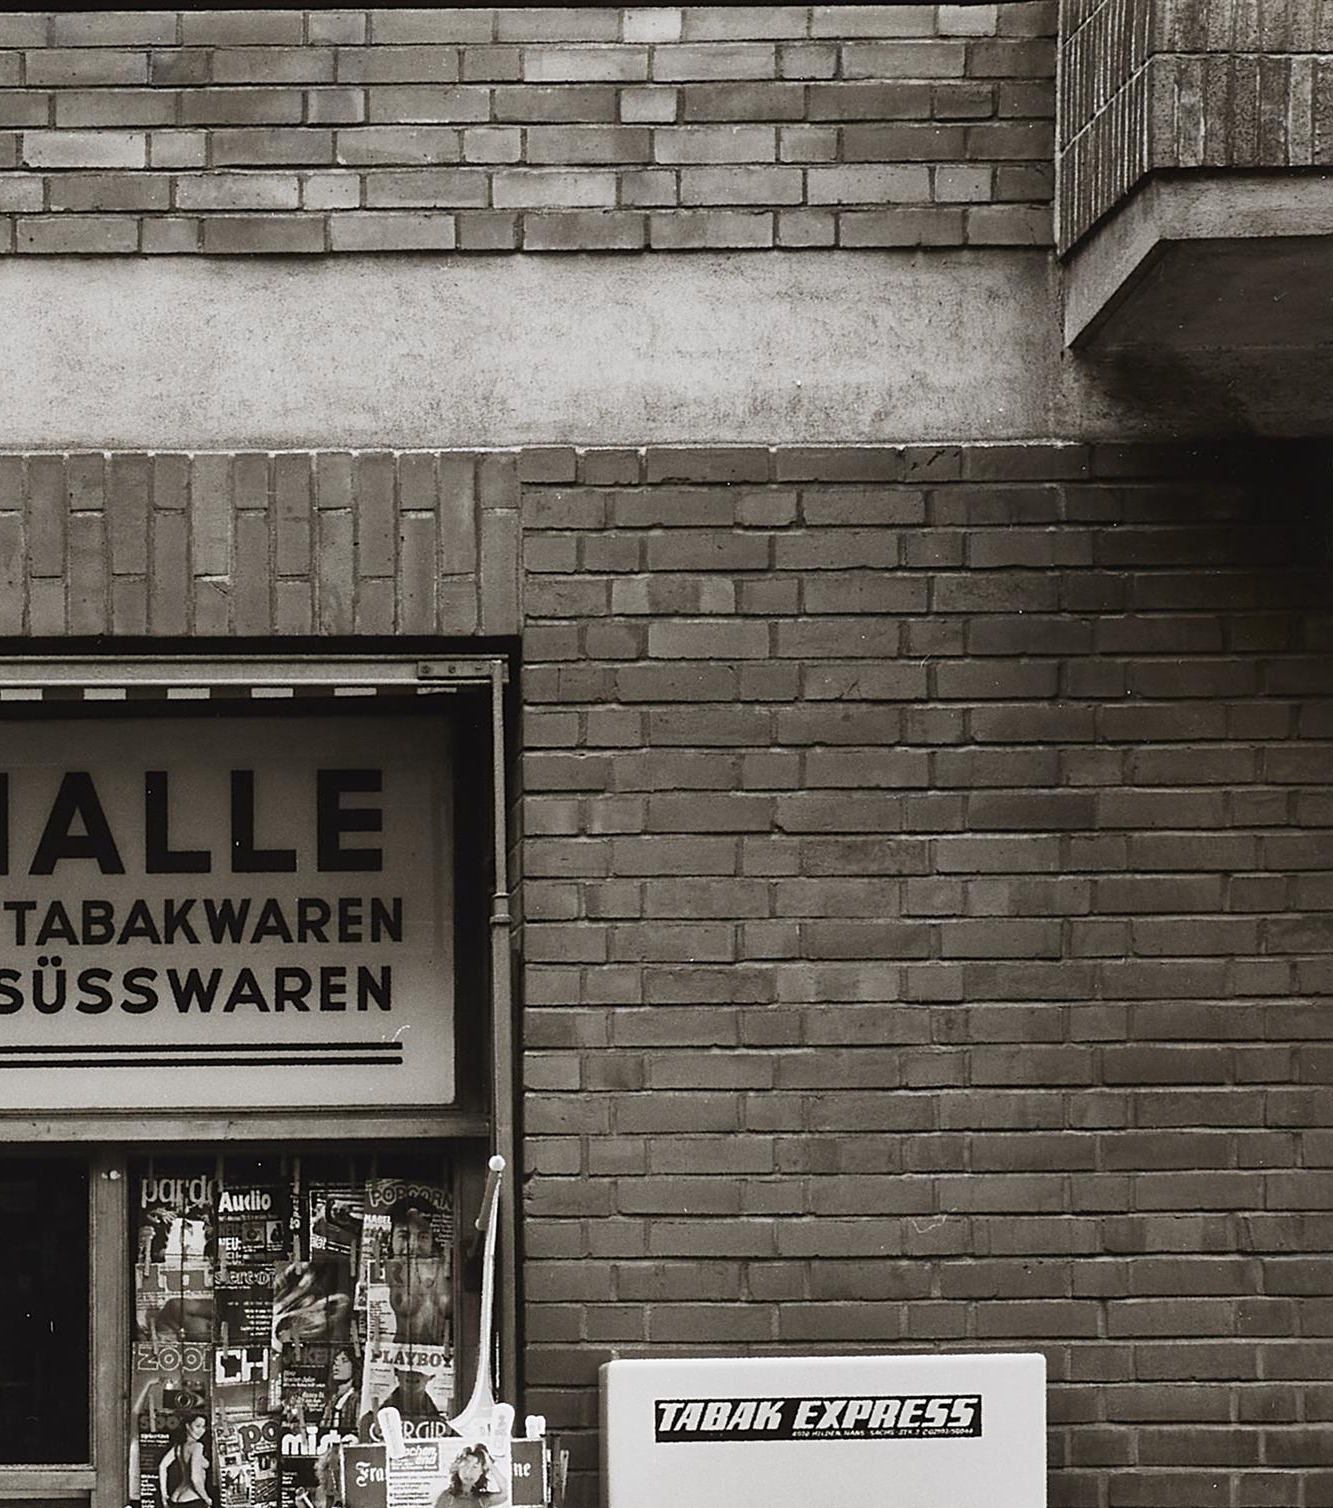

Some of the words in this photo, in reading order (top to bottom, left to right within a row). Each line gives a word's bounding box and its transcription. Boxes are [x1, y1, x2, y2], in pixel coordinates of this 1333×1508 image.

[3, 896, 404, 947] TABAKWAREN
[218, 1190, 272, 1213] Audio
[370, 1349, 454, 1368] PLAYBOY
[658, 1401, 785, 1432] TABAK
[792, 1397, 978, 1429] EXPRESS
